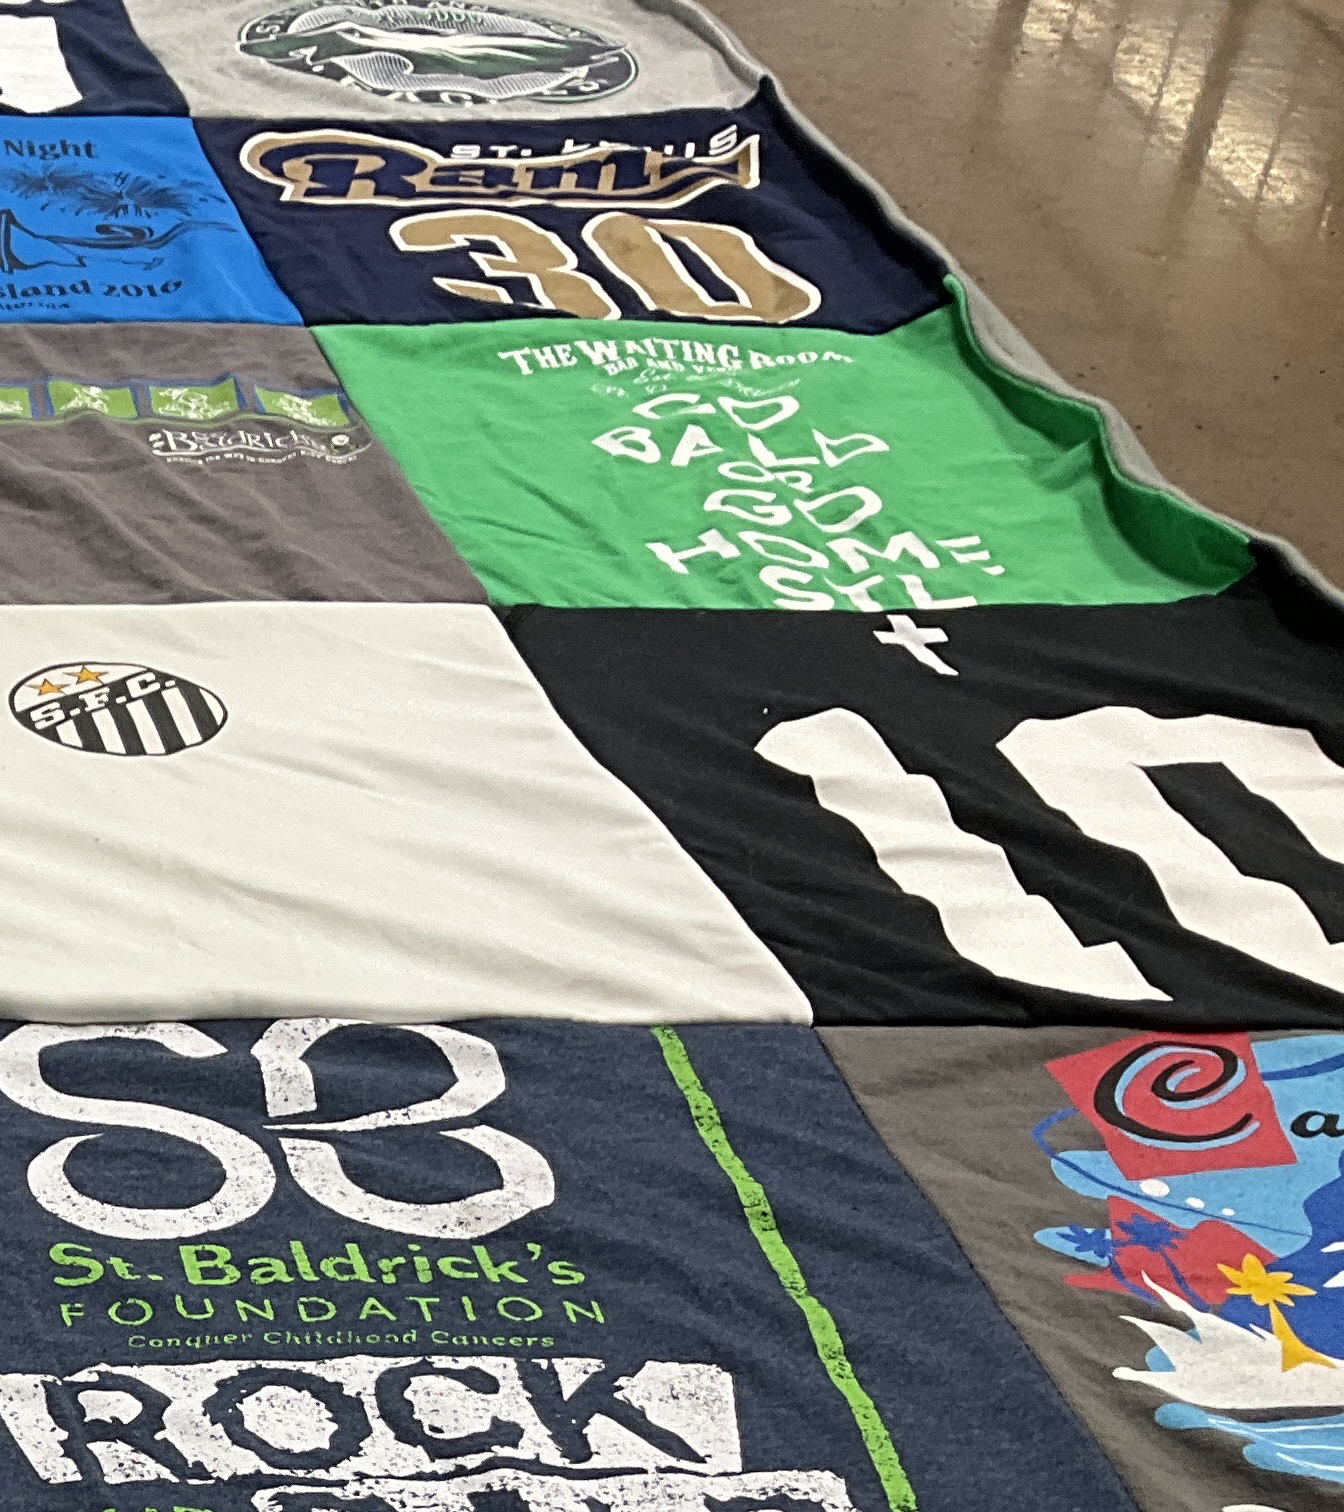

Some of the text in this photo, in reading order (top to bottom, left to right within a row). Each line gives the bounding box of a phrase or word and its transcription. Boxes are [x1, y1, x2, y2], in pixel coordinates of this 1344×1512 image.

[3, 139, 99, 160] Night
[389, 209, 822, 323] 30
[499, 336, 855, 378] THE WAITING ROOM
[591, 423, 891, 467] BALD
[718, 460, 813, 494] OR
[30, 670, 177, 731] S.F.C.
[48, 1238, 587, 1289] St. Baldrick's
[59, 1295, 608, 1328] FOUNDATION
[126, 1330, 253, 1350] Conquer
[430, 1330, 557, 1349] Cancers
[47, 1359, 714, 1483] ROCK
